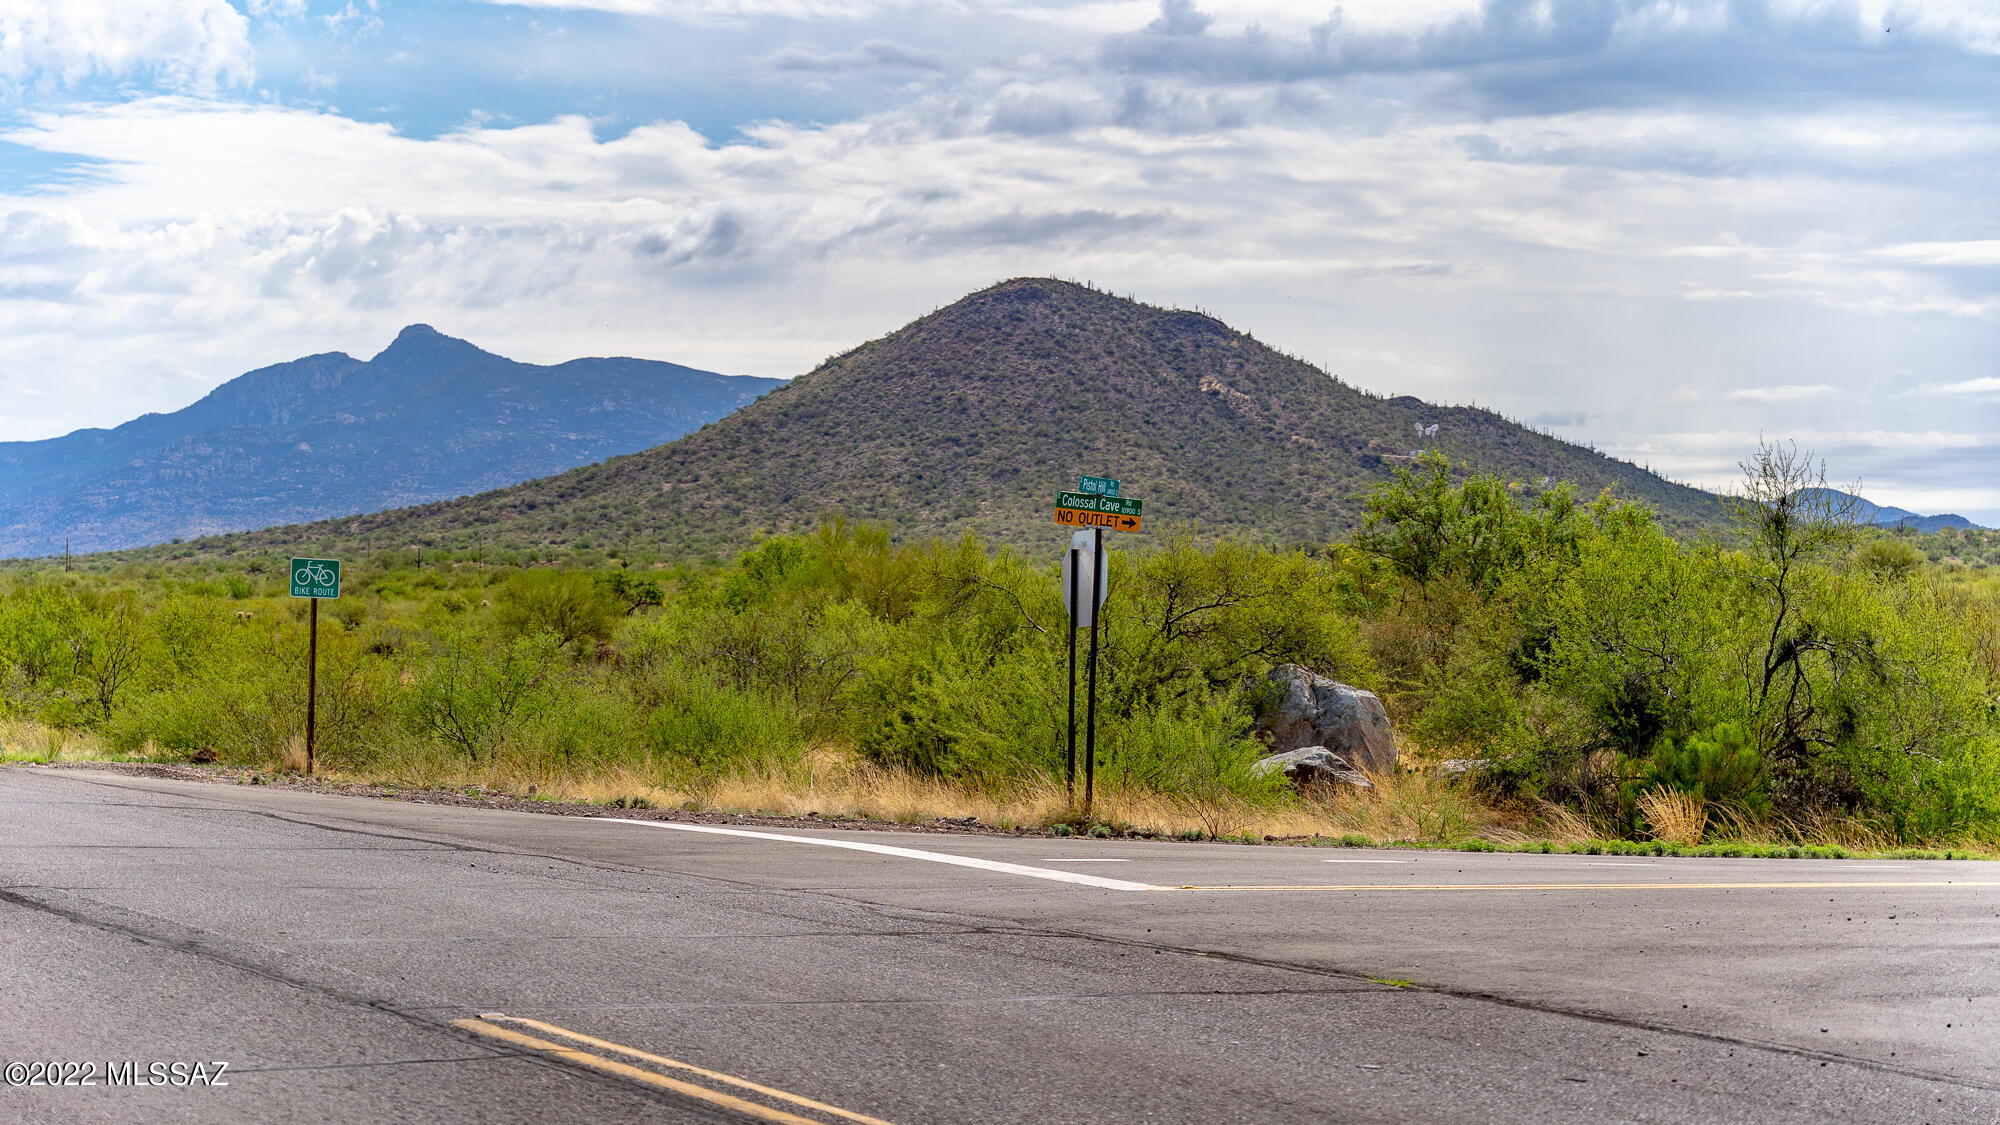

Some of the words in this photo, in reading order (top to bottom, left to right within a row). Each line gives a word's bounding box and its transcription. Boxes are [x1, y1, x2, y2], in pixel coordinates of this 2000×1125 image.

[1082, 478, 1097, 493] Pistol
[1097, 480, 1107, 494] Hill
[1062, 494, 1097, 510] Colossal
[1099, 498, 1120, 512] Cave
[1125, 499, 1133, 507] Rd
[1121, 507, 1136, 515] 10900
[1057, 510, 1074, 523] NO
[1078, 512, 1120, 528] OUTLET
[294, 586, 310, 595] BIKE
[313, 587, 335, 596] ROUTE
